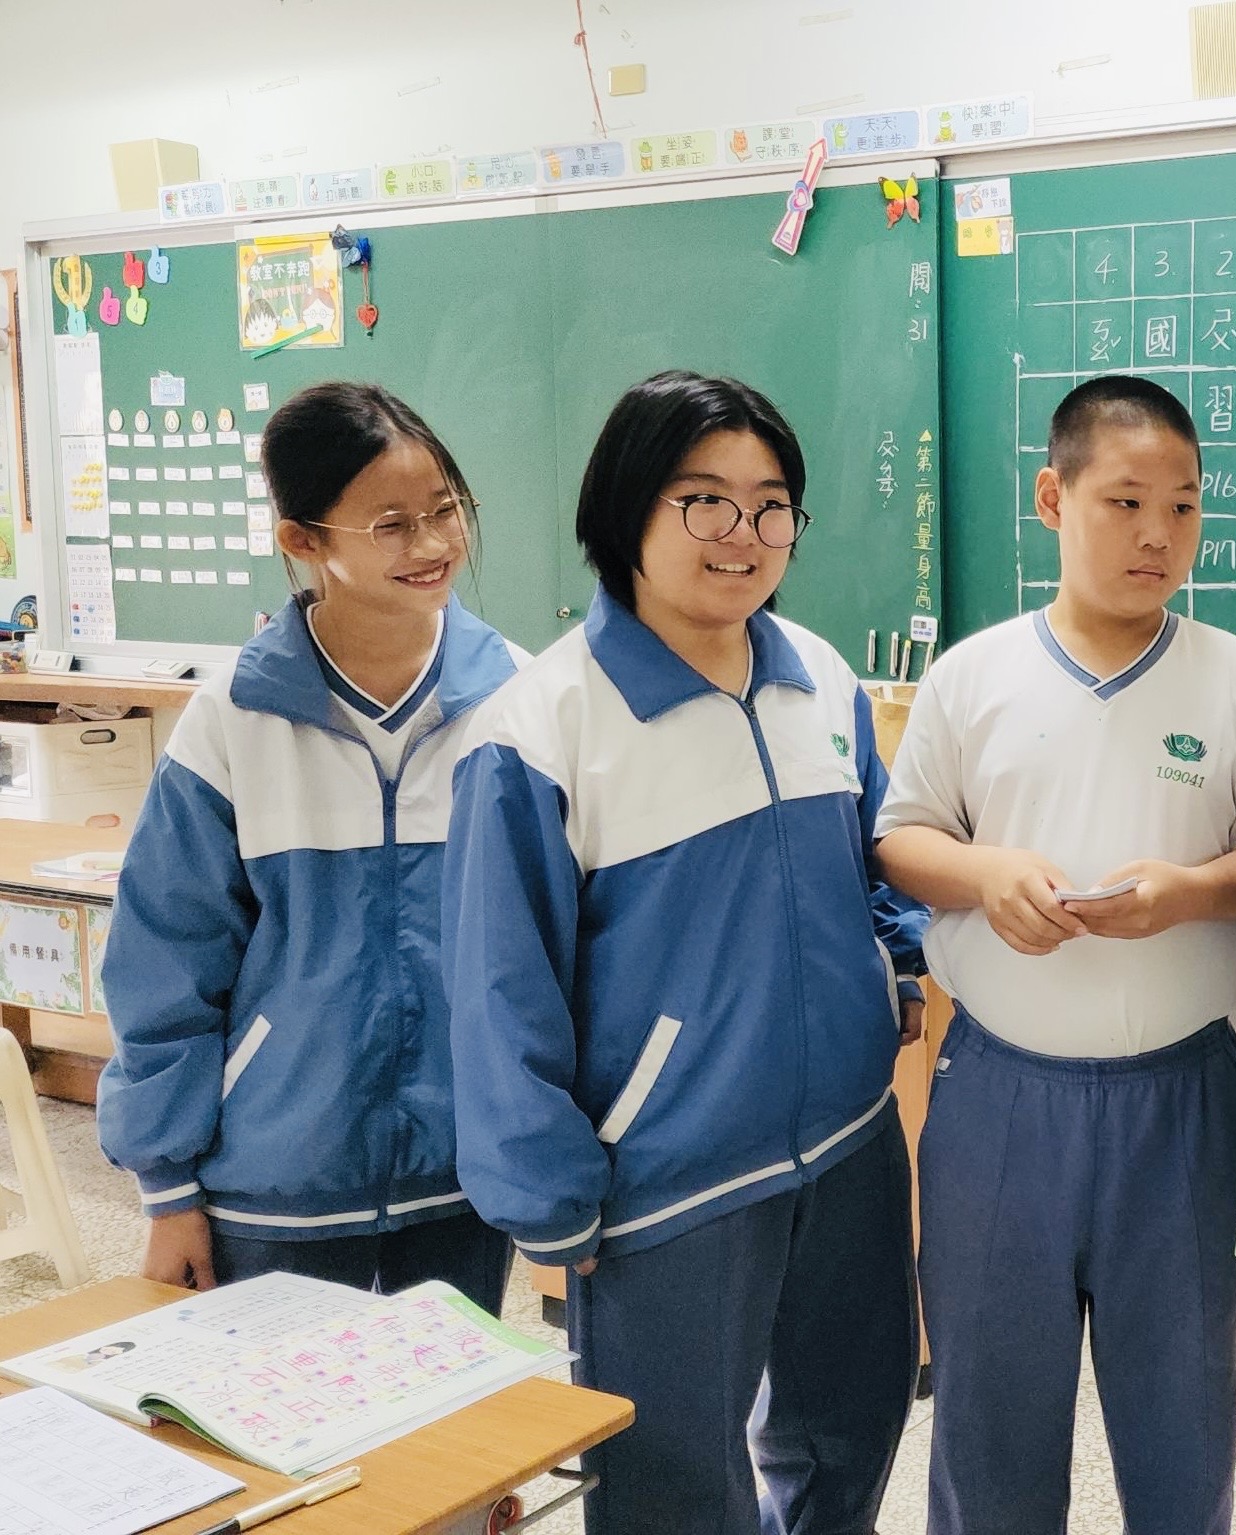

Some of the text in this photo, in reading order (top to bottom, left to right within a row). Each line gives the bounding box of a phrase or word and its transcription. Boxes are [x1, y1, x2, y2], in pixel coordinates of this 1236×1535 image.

[864, 116, 895, 133] 天天
[971, 120, 1002, 138] 學習
[666, 135, 694, 151] 坐姿
[762, 127, 792, 142] 課堂
[856, 133, 904, 151] 更進步
[755, 142, 801, 160] 守秩序
[410, 165, 434, 179] 小口
[250, 260, 310, 281] 教室不奔跑
[1145, 315, 1177, 358] 國
[1204, 385, 1233, 432] 習
[912, 445, 936, 611] 第二節量身高
[1156, 766, 1205, 789] 109041
